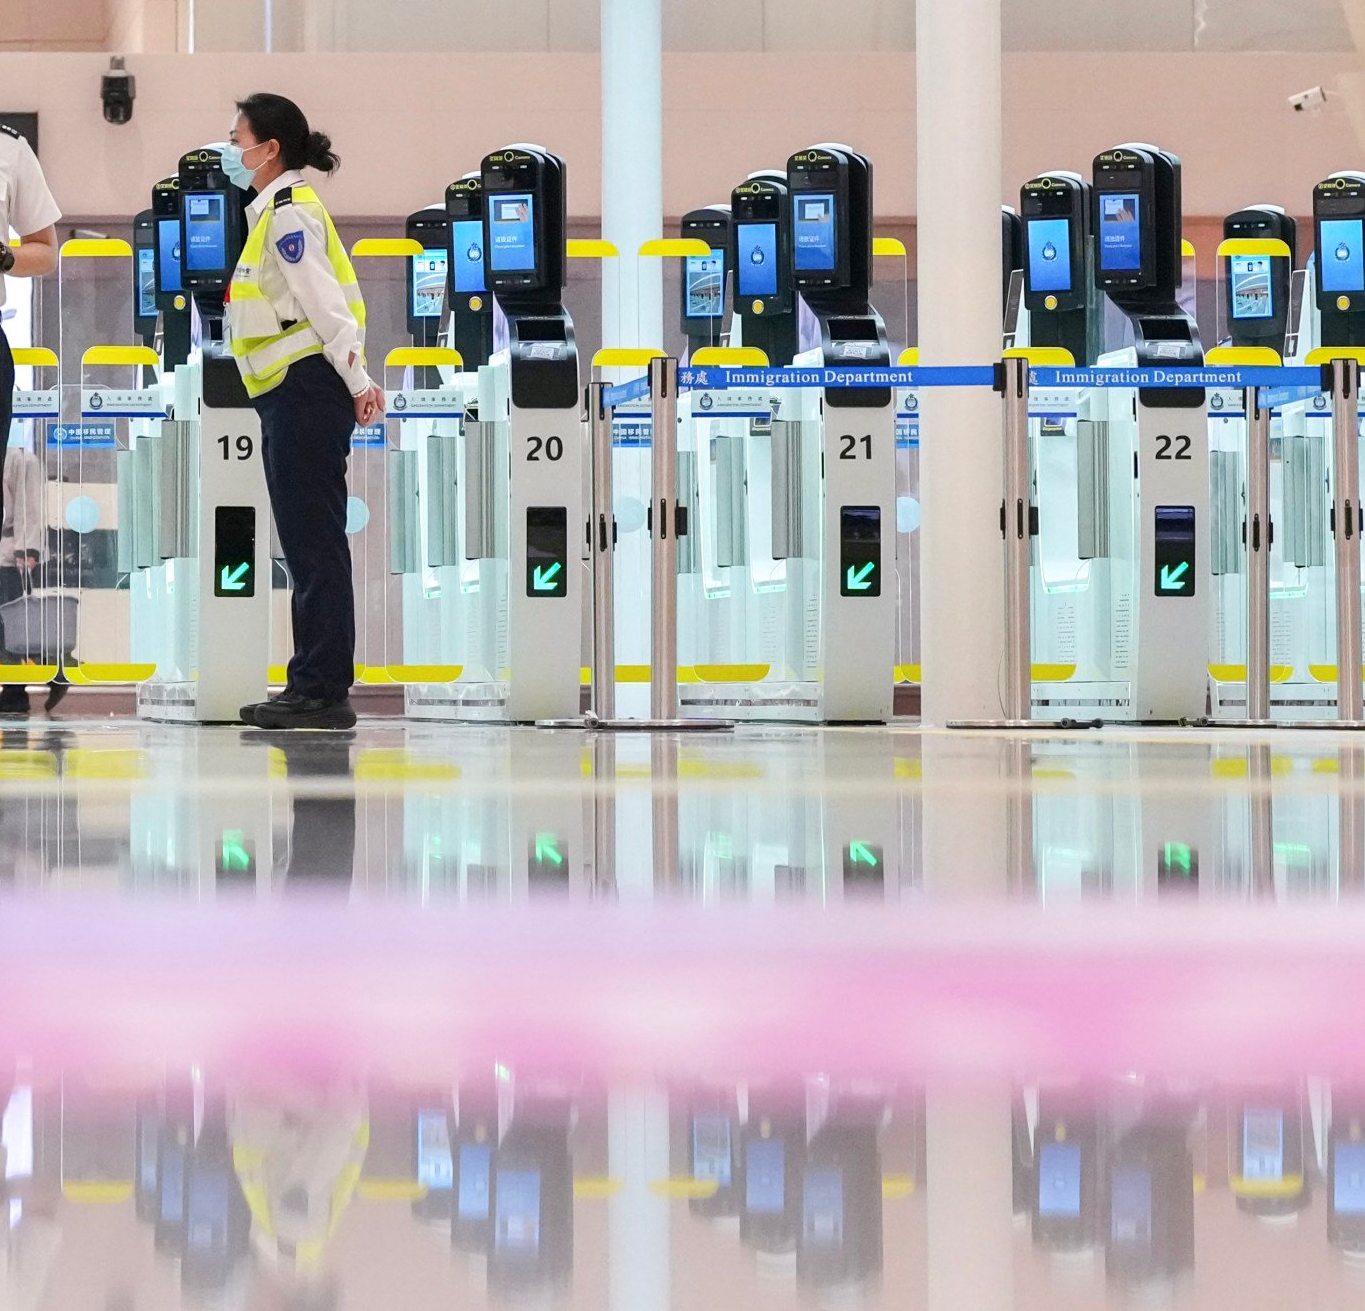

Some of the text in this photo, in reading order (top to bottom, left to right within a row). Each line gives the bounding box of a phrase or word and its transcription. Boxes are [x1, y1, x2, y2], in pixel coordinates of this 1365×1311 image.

[680, 370, 709, 385] 務處
[725, 370, 914, 386] Immigration Department
[1055, 370, 1242, 386] Immigration Department
[613, 428, 652, 436] 中国移民管
[217, 435, 254, 461] 19
[526, 435, 564, 462] 20
[839, 434, 872, 460] 21
[1155, 434, 1192, 460] 22
